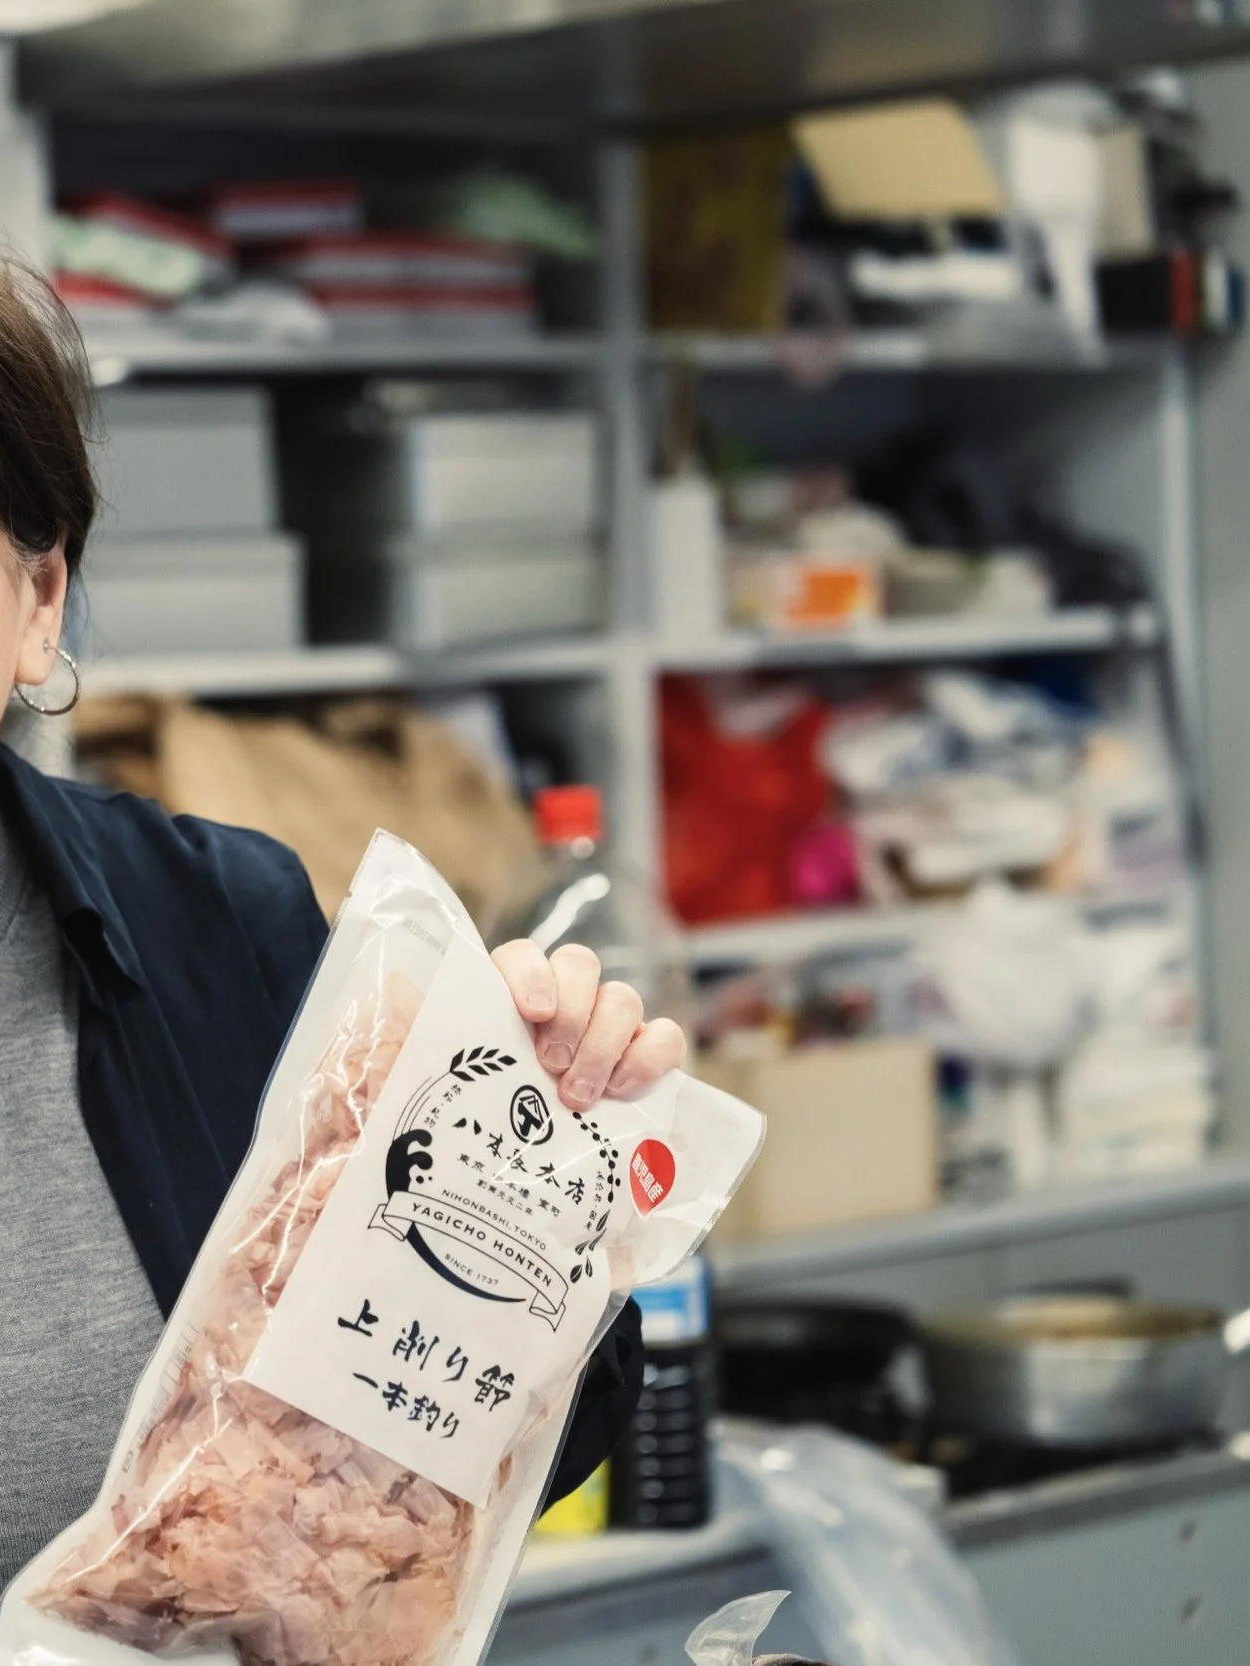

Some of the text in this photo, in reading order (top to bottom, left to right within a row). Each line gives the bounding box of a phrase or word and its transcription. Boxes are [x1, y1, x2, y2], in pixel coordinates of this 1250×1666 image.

[411, 1203, 553, 1288] YAGICHO HONTEN
[514, 1224, 547, 1251] TOKYO
[444, 1253, 500, 1287] SINCE 1737
[352, 1372, 460, 1439] 一本釣り
